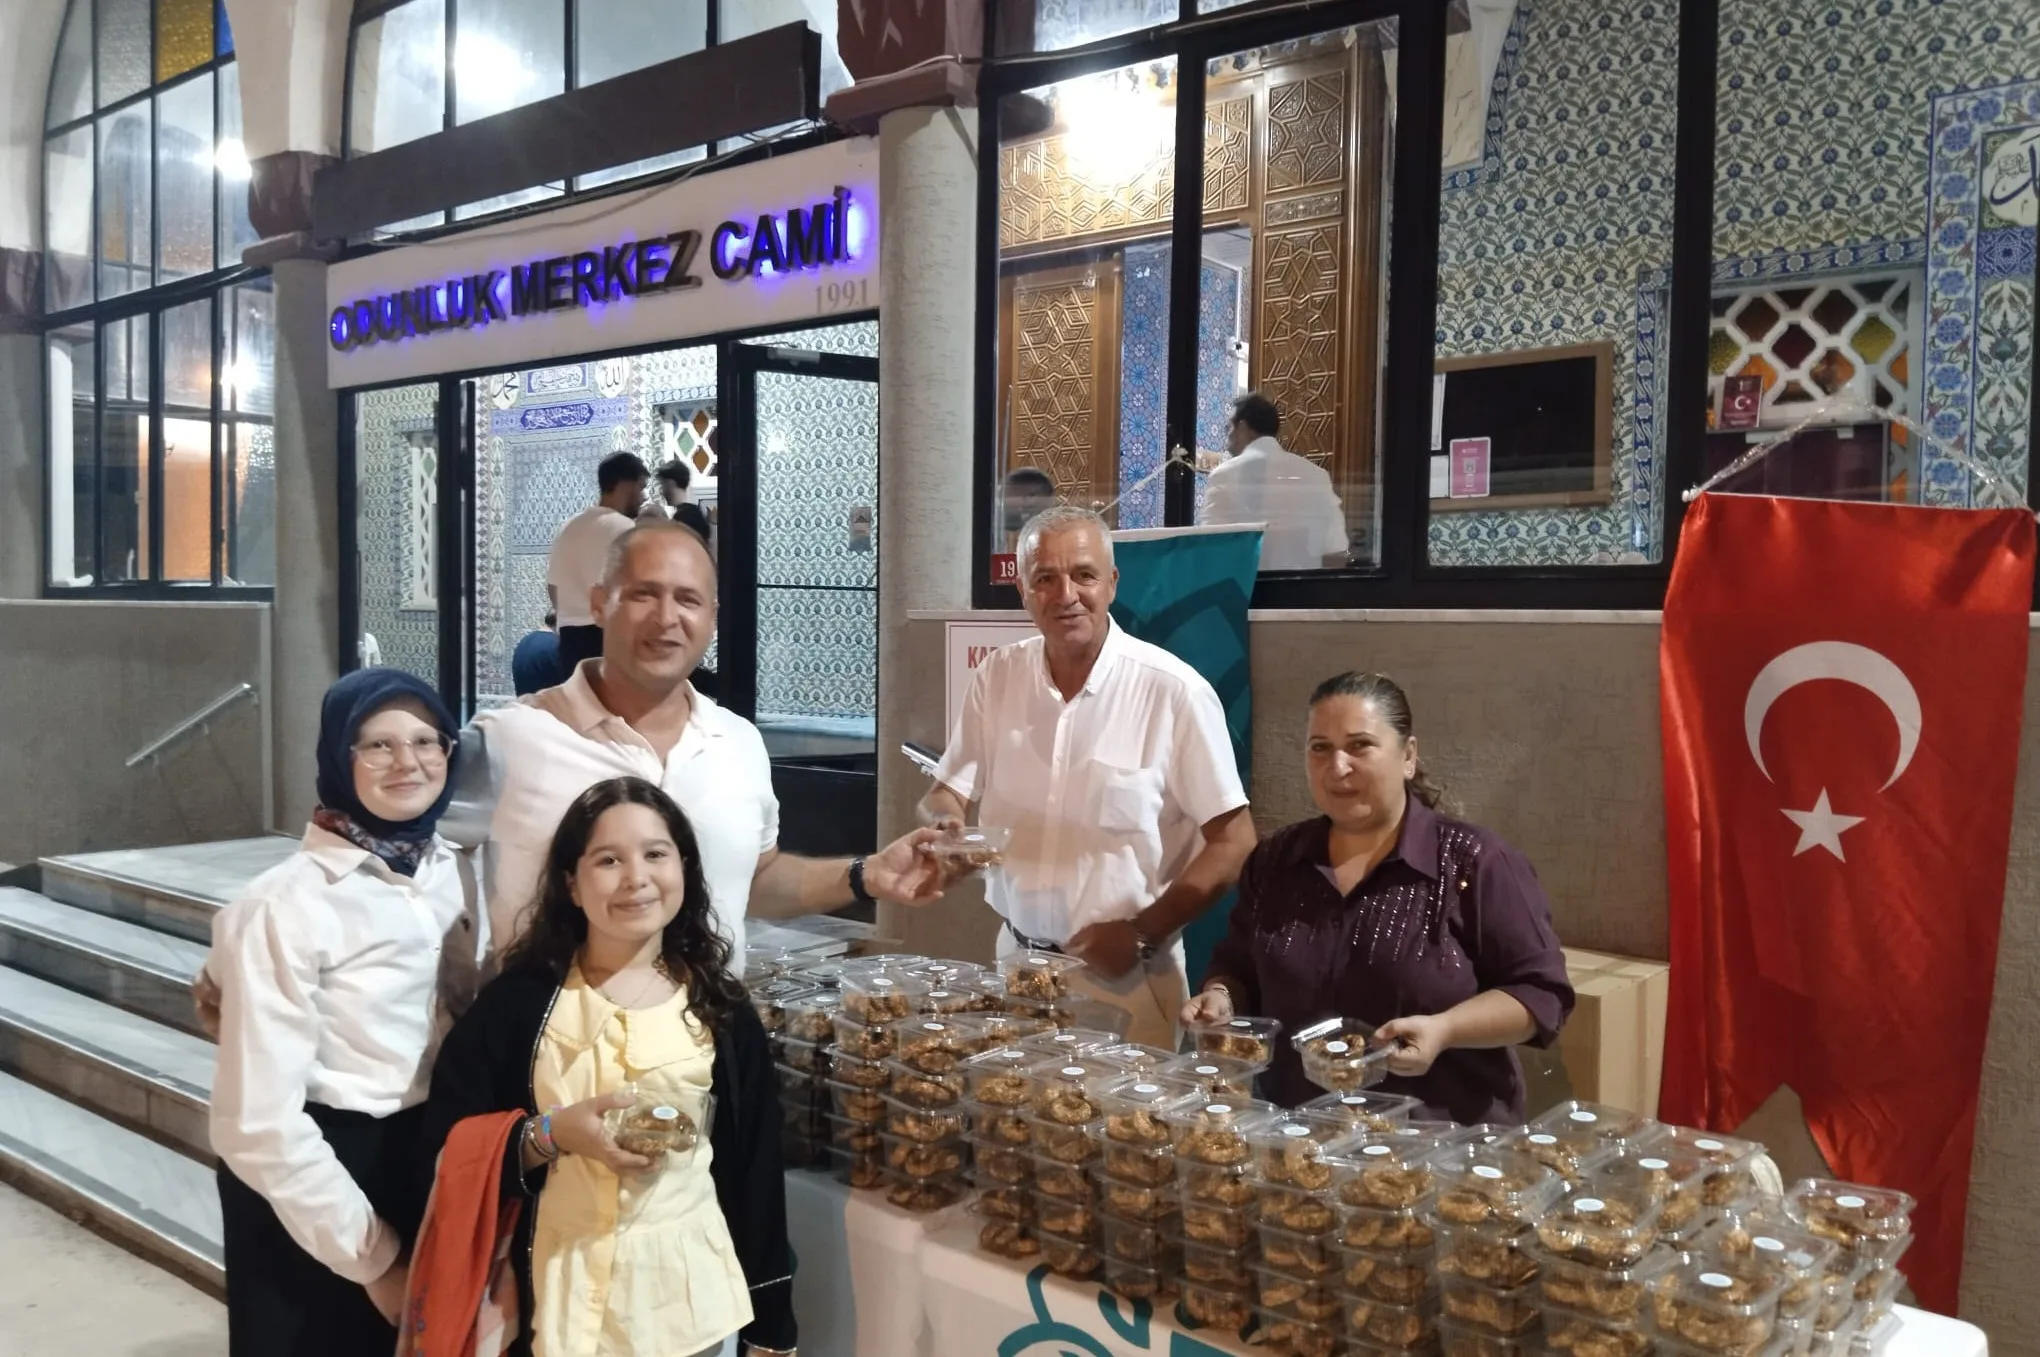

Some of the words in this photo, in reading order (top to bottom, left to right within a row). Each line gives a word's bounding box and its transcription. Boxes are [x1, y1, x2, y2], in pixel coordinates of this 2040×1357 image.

[330, 271, 507, 351] ODUNLUK
[511, 230, 703, 316] MERKEZ
[711, 185, 852, 281] CAMİ
[816, 278, 868, 315] 1991
[968, 646, 998, 668] KA
